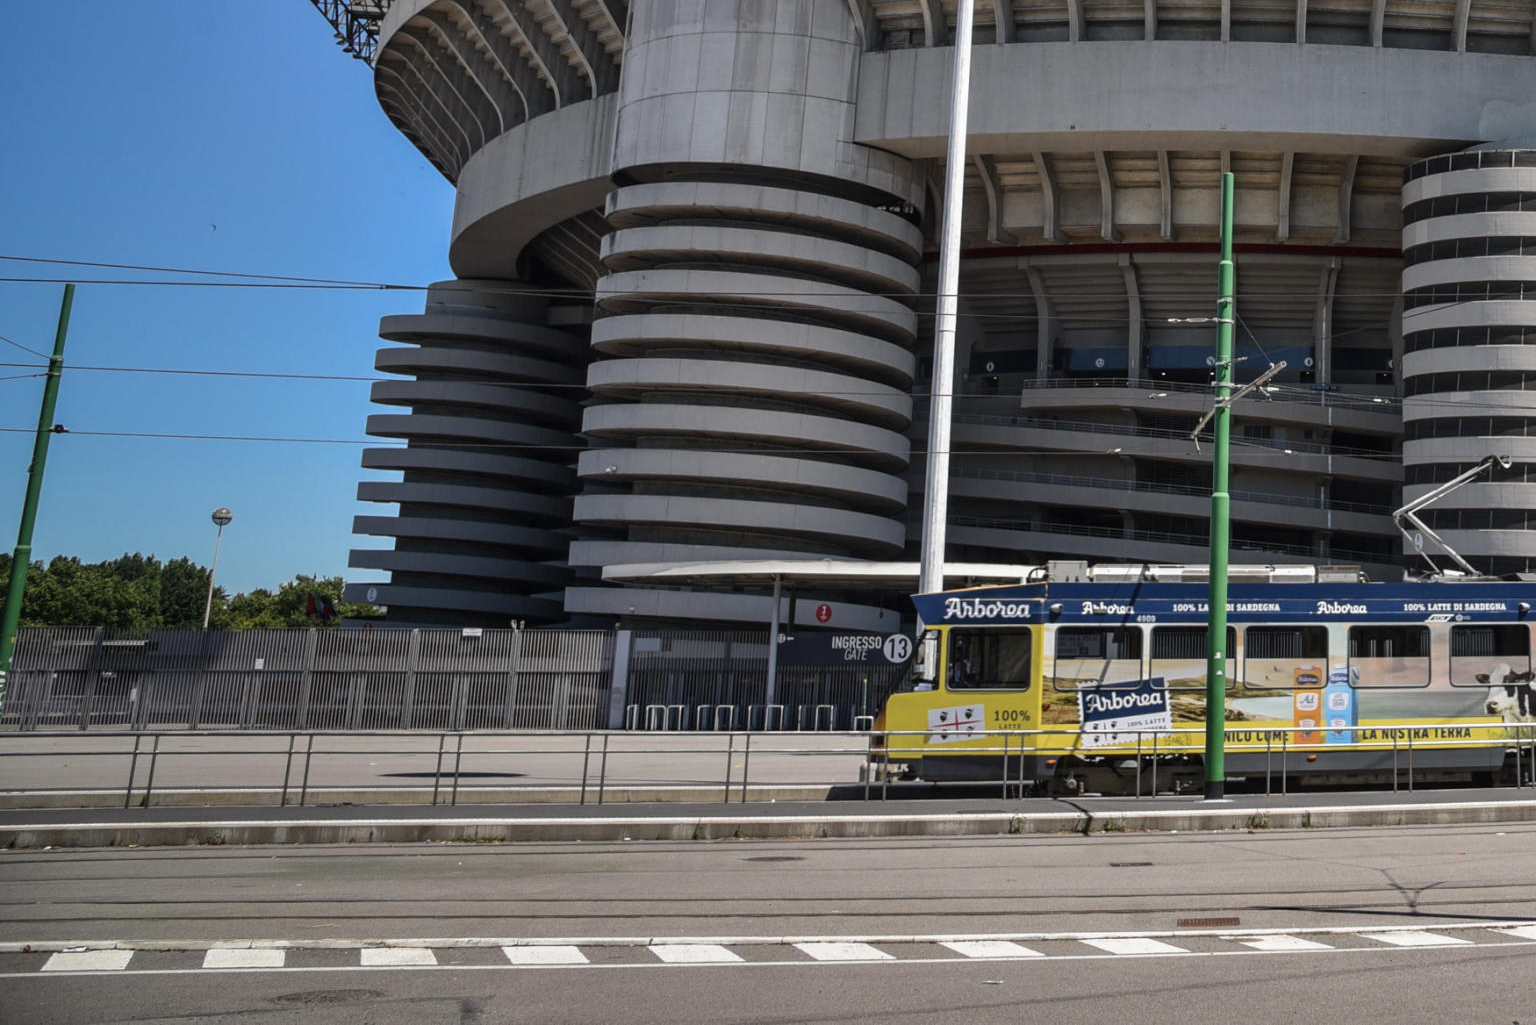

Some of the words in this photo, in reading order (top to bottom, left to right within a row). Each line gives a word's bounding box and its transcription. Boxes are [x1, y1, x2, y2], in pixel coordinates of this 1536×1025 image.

[944, 597, 1031, 620] Arborea
[1081, 601, 1135, 615] Arborea
[1172, 603, 1196, 612] 100%
[1225, 603, 1235, 612] DI
[1236, 603, 1281, 612] SARDEGNA
[1316, 600, 1368, 615] Arborea
[1403, 603, 1426, 611] 100%
[1427, 603, 1452, 611] LATTE
[1453, 603, 1463, 611] DI
[1464, 602, 1507, 611] SARDEGNA
[1136, 614, 1156, 623] 4909
[832, 635, 882, 650] INGRESSO
[887, 637, 909, 660] 13
[844, 649, 868, 661] GATE
[1085, 691, 1164, 714] Arborea
[994, 709, 1031, 722] 100%
[1145, 717, 1166, 726] LATTE
[1223, 730, 1252, 743] NICO
[1256, 730, 1289, 743] COME
[1362, 728, 1377, 740] LA
[1381, 727, 1429, 740] NOSTRA
[1434, 727, 1472, 739] TERRA
